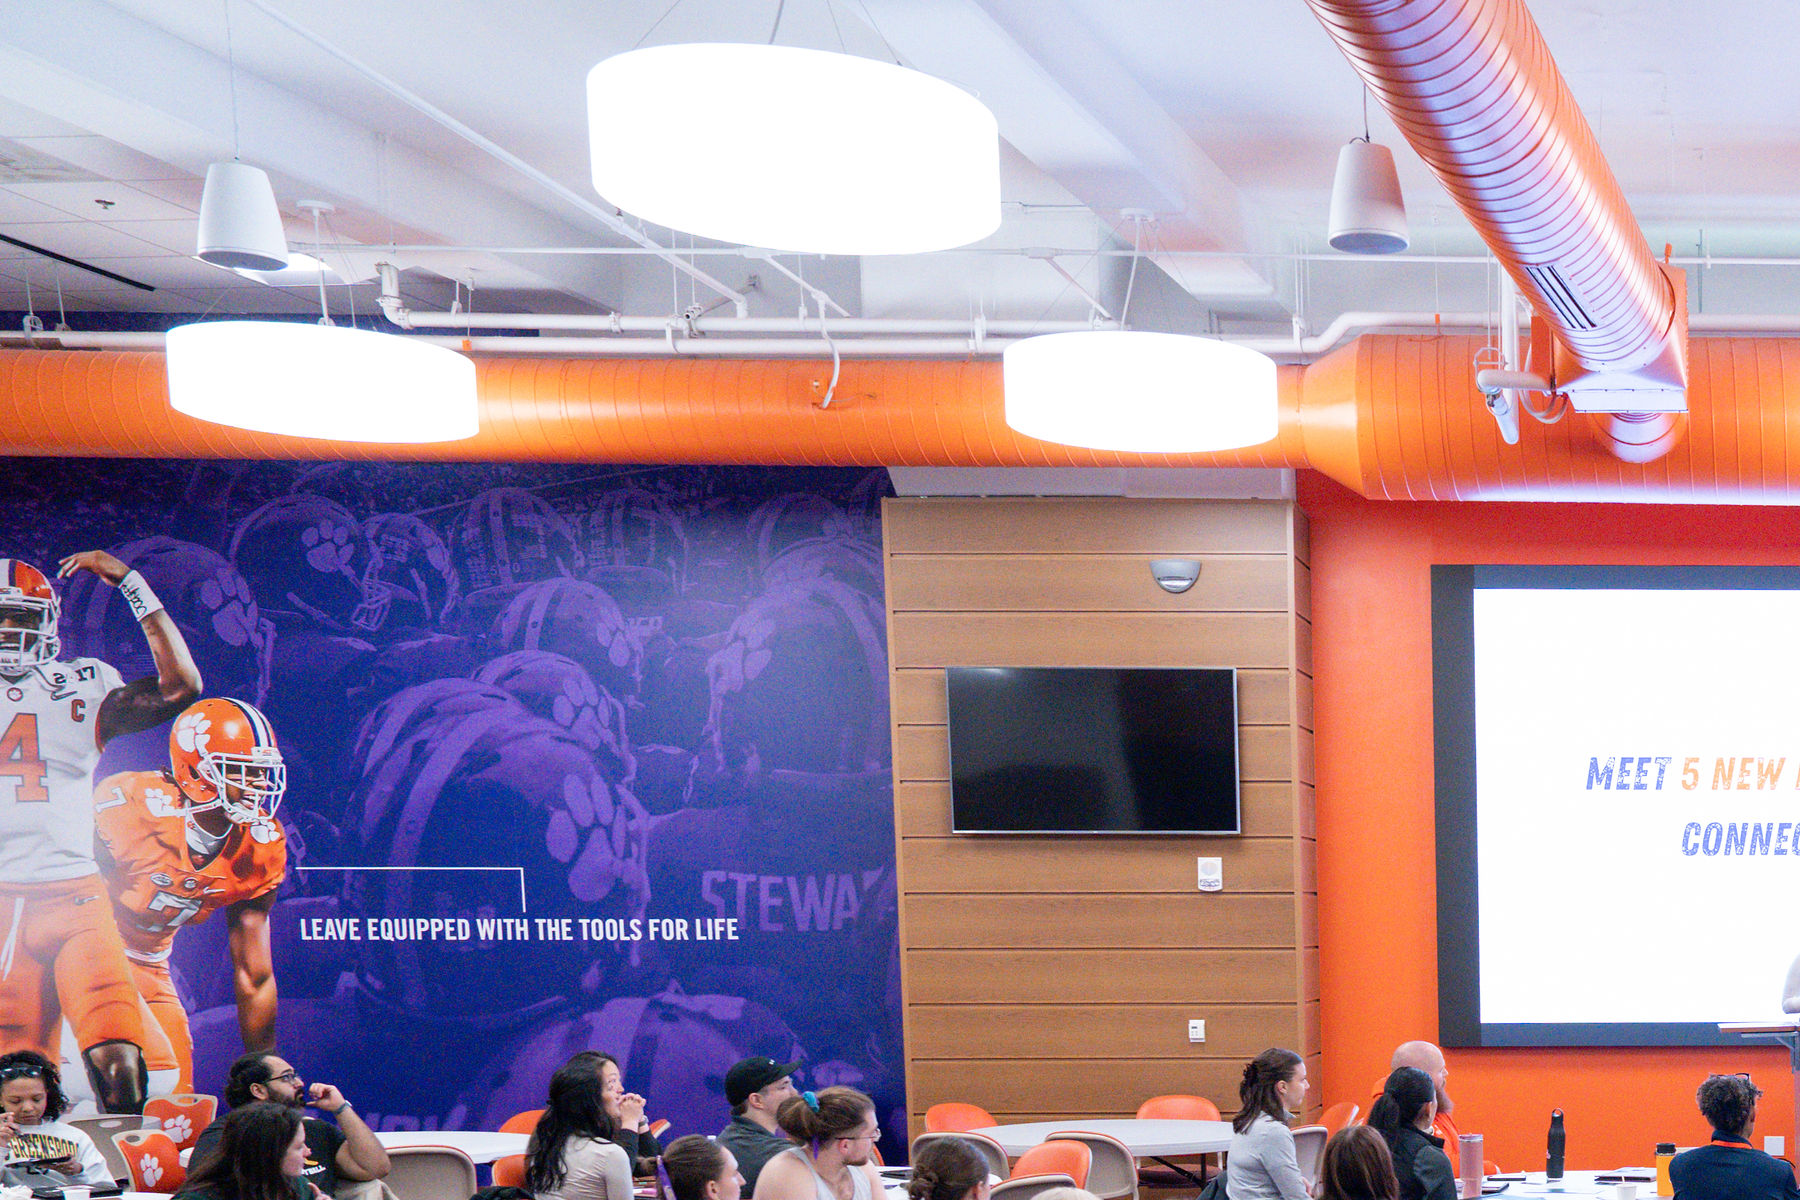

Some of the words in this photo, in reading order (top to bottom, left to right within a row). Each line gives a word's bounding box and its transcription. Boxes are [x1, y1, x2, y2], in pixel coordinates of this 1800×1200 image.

[71, 699, 86, 722] C
[0, 712, 50, 803] 4
[1586, 756, 1672, 791] MEET
[1681, 756, 1701, 791] 5
[1711, 756, 1787, 791] NEW
[300, 918, 361, 941] LEAVE
[367, 918, 470, 942] EQUIPPED
[476, 918, 529, 941] WITH
[534, 918, 573, 941] THE
[578, 918, 642, 941] TOOLS
[649, 918, 688, 941] FOR
[695, 918, 740, 941] LIFE
